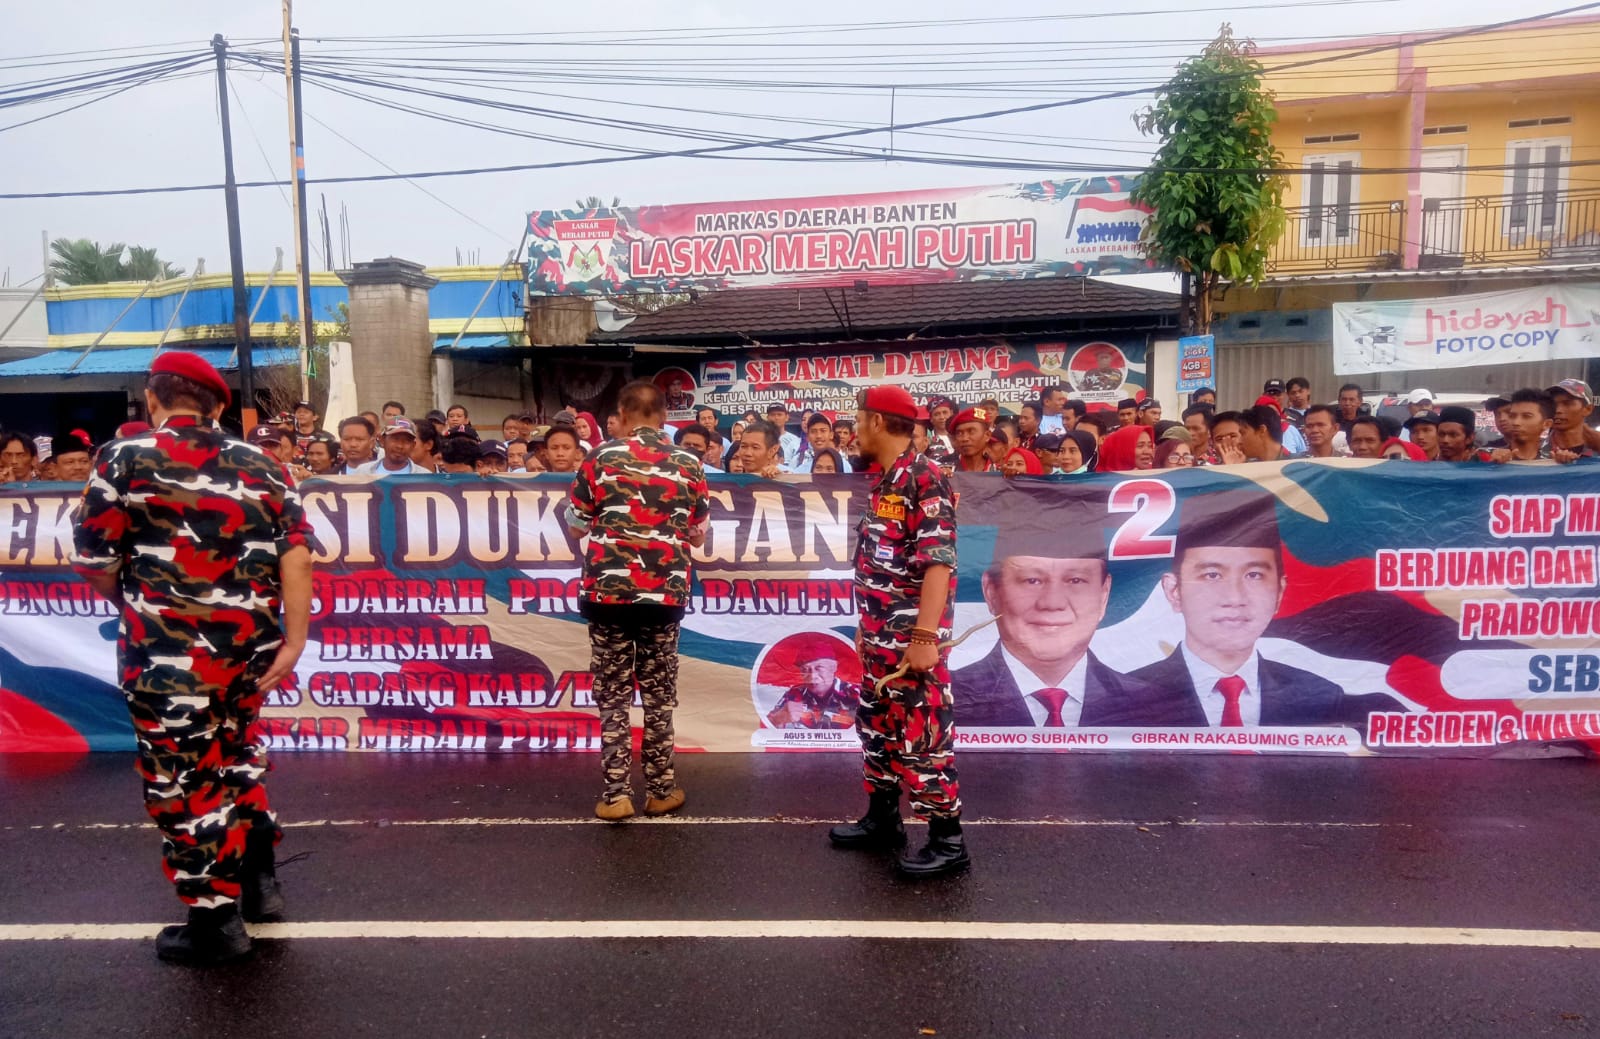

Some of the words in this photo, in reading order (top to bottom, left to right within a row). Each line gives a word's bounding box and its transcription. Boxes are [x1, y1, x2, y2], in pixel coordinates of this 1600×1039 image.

[572, 222, 599, 230] LASKAR
[696, 210, 778, 233] MARKAS
[784, 206, 867, 229] DAERAH
[873, 202, 957, 224] BANTEN
[631, 237, 766, 278] LASKAR
[773, 226, 906, 272] MERAH
[915, 219, 1035, 268] PUTIH
[1065, 245, 1097, 255] LASKAR
[1099, 243, 1129, 253] MERAH
[1404, 297, 1591, 346] hidayah
[1436, 335, 1495, 354] FOTO
[1500, 328, 1560, 349] COPY
[745, 355, 875, 385] SELAMAT
[883, 345, 1011, 377] DATANG
[1182, 360, 1202, 371] 4GB
[703, 391, 750, 405] KETUA
[750, 388, 790, 403] UMUM
[793, 386, 849, 400] MARKAS
[959, 378, 1011, 392] MERAH
[1015, 375, 1060, 388] PUTIH
[721, 402, 769, 416] BESERT
[1000, 390, 1041, 403] KE-23
[1108, 479, 1177, 561] 2
[1491, 498, 1562, 534] SIAP
[1379, 550, 1526, 587] BERJUANG
[1534, 549, 1594, 586] DAN
[334, 579, 487, 614] DAERAH
[702, 580, 855, 615] BANTEN
[321, 626, 494, 660] BERSAMA
[309, 672, 456, 709] CABANG
[1528, 654, 1600, 694] SEB
[359, 717, 488, 750] MERAH
[783, 732, 806, 740] AGUS
[814, 732, 842, 740] WILLYS
[952, 733, 1027, 744] PRABOWO
[1031, 733, 1108, 744] SUBIANTO
[1131, 733, 1190, 745] GIBRAN
[1194, 733, 1299, 746] RAKABUMING
[1304, 734, 1349, 746] RAKA
[1370, 713, 1494, 744] PRESIDEN
[1498, 718, 1519, 741] &
